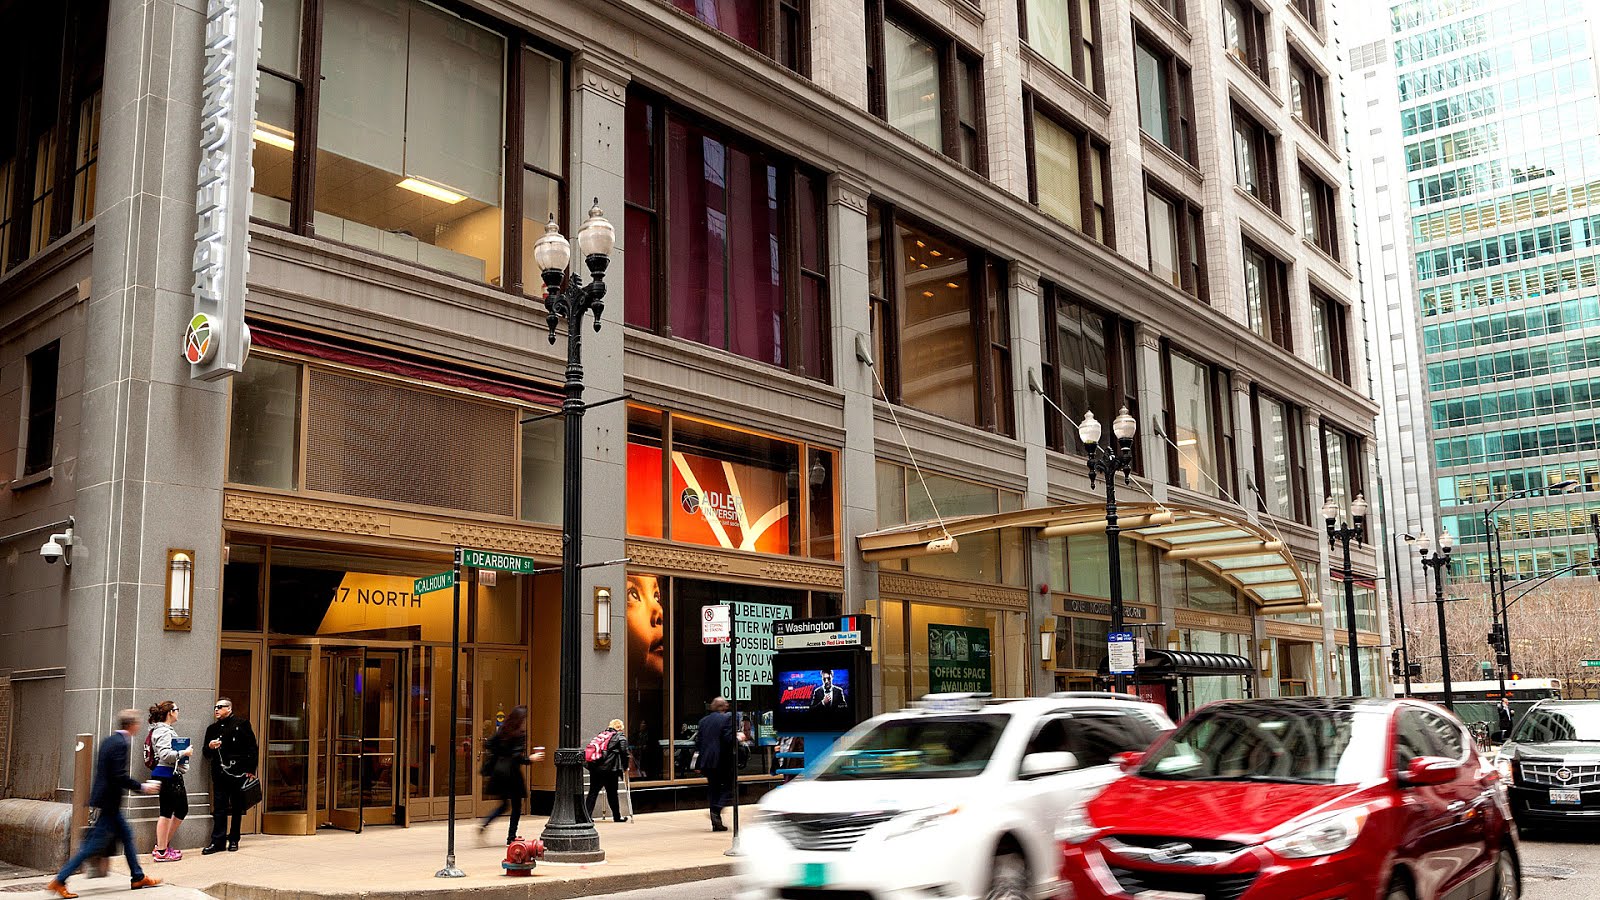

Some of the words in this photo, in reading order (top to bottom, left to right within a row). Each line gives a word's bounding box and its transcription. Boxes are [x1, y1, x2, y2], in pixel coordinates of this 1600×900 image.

[192, 150, 227, 300] ADLER
[702, 490, 742, 512] ADLER
[702, 506, 743, 521] UNIVERSITY
[472, 552, 521, 570] DEARBORN
[524, 561, 530, 569] ST
[418, 574, 446, 593] CALHOUN
[332, 587, 350, 602] 17
[357, 588, 421, 608] NORTH
[743, 604, 781, 619] BELIEVE
[784, 608, 790, 620] A
[1071, 600, 1085, 612] ONE
[735, 620, 759, 633] TTER
[785, 621, 835, 633] Washington
[735, 637, 773, 650] POSSIBL
[722, 652, 743, 666] AD
[745, 653, 764, 666] YOU
[738, 669, 751, 682] BE
[753, 670, 759, 682] A
[762, 671, 773, 682] PA
[935, 666, 961, 679] OFFICE
[963, 667, 986, 679] SPACE
[739, 686, 749, 699] IT.
[940, 681, 981, 692] AVAILABLE
